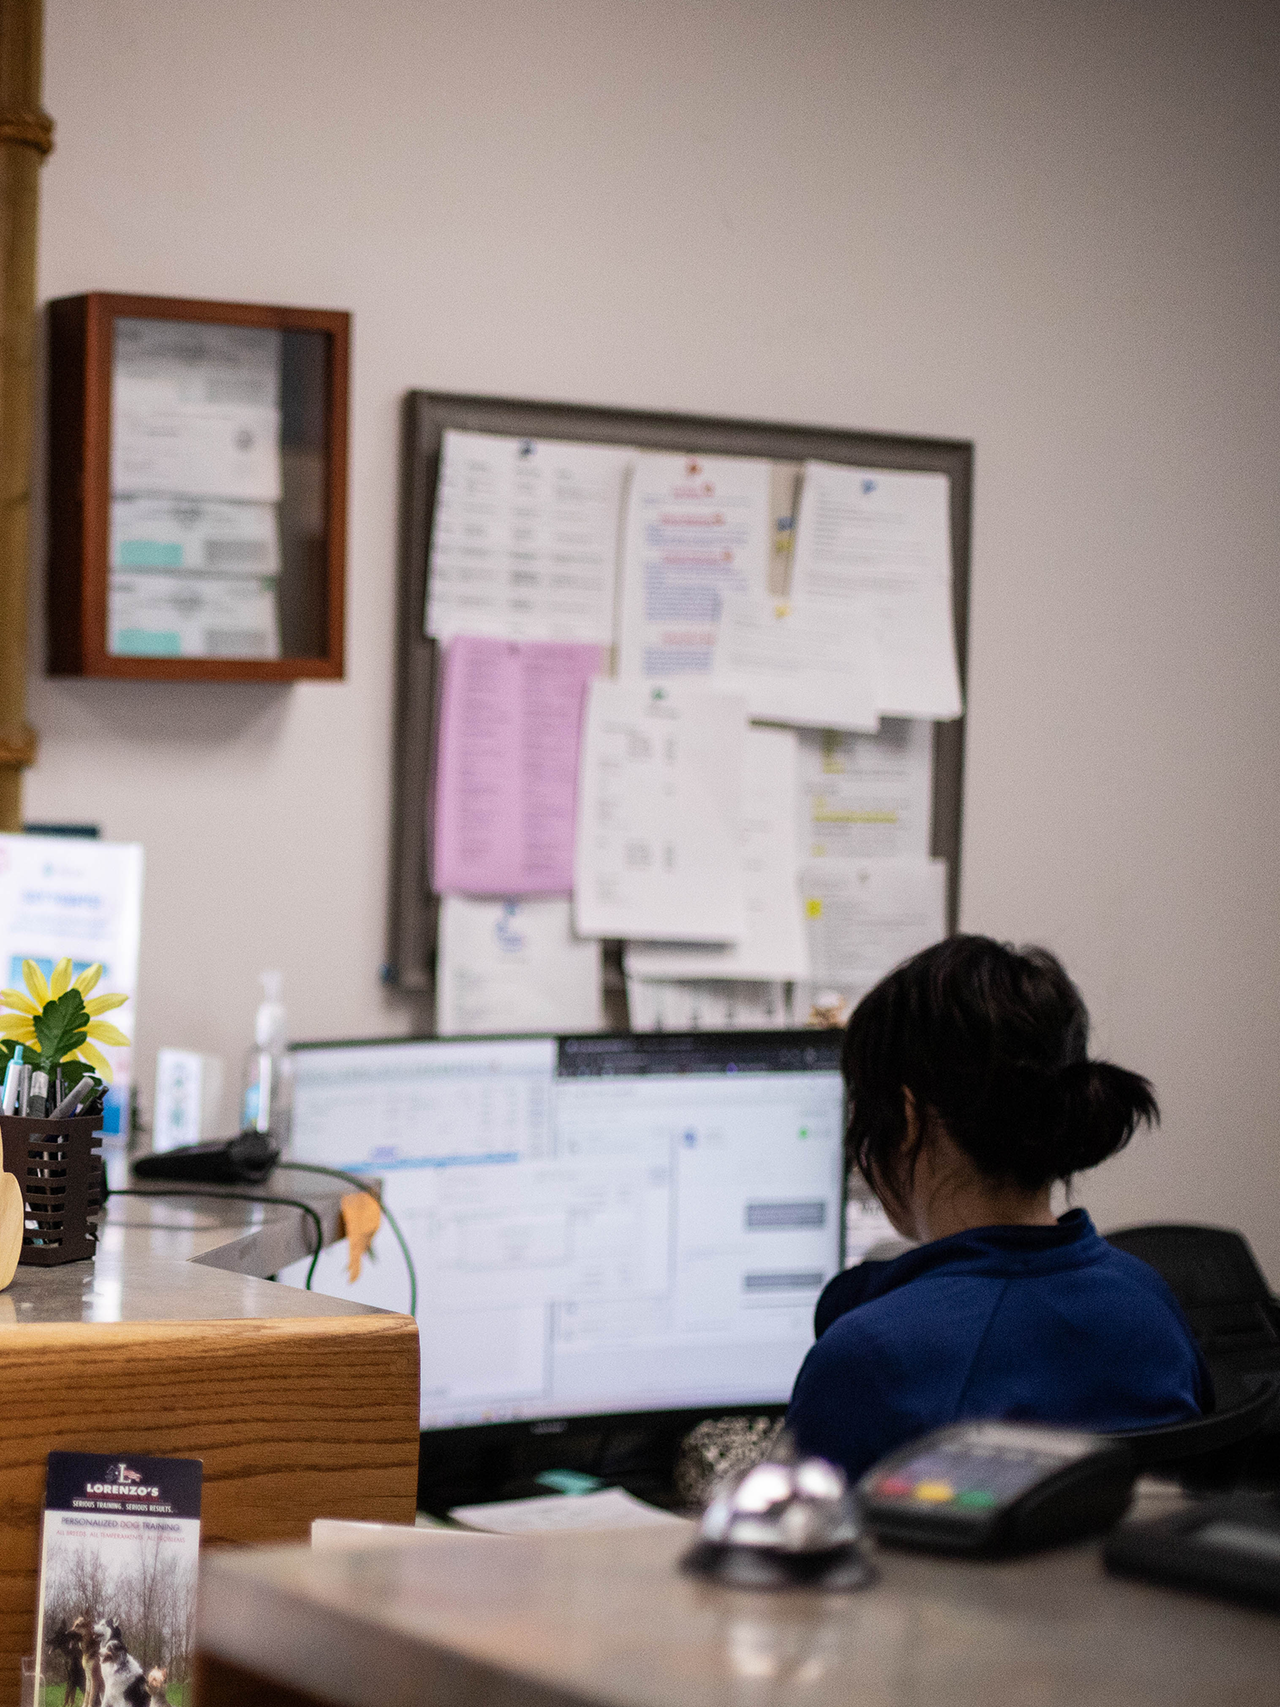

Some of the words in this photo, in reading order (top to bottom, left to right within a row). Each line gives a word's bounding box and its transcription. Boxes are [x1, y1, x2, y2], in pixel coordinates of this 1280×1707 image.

[86, 1483, 159, 1497] LORENZO'S
[72, 1499, 95, 1508] SERIOUS
[96, 1501, 124, 1510] TRAINING.
[125, 1503, 148, 1512] SERIOUS
[149, 1505, 174, 1514] RESULTS.
[61, 1516, 118, 1528] PERSONALIZED
[120, 1520, 140, 1530] DOG
